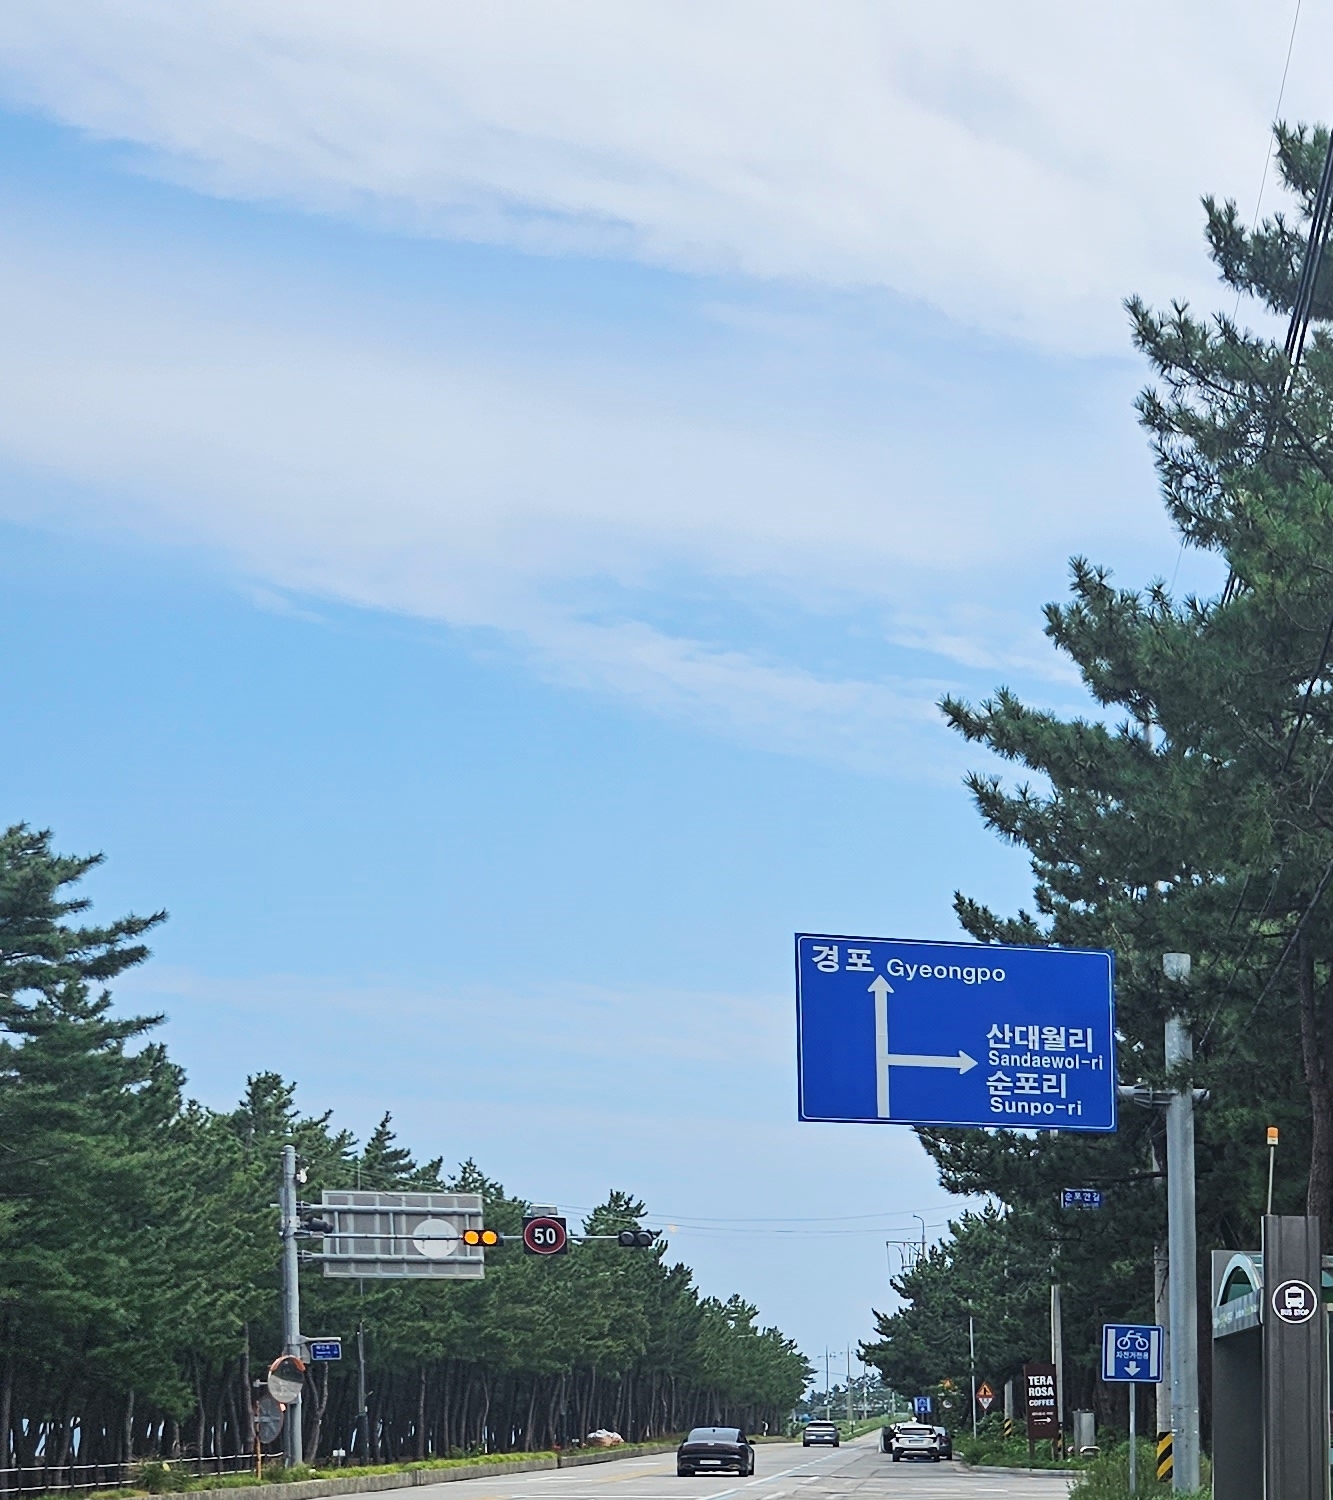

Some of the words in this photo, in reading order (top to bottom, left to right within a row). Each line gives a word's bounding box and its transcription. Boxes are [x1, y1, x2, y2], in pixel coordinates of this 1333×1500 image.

[811, 944, 875, 973] 경포
[886, 958, 1006, 985] Gyeongpo
[985, 1023, 1093, 1053] 산대월리
[988, 1050, 1104, 1070] Sandaewol-ri
[985, 1071, 1067, 1098] 순포리
[989, 1097, 1082, 1116] Sunpo-ri
[534, 1228, 556, 1244] 50
[1116, 1350, 1149, 1360] 자전거전용
[1027, 1375, 1054, 1386] TERA
[1028, 1386, 1055, 1397] ROSA
[1028, 1398, 1055, 1407] COFFEE
